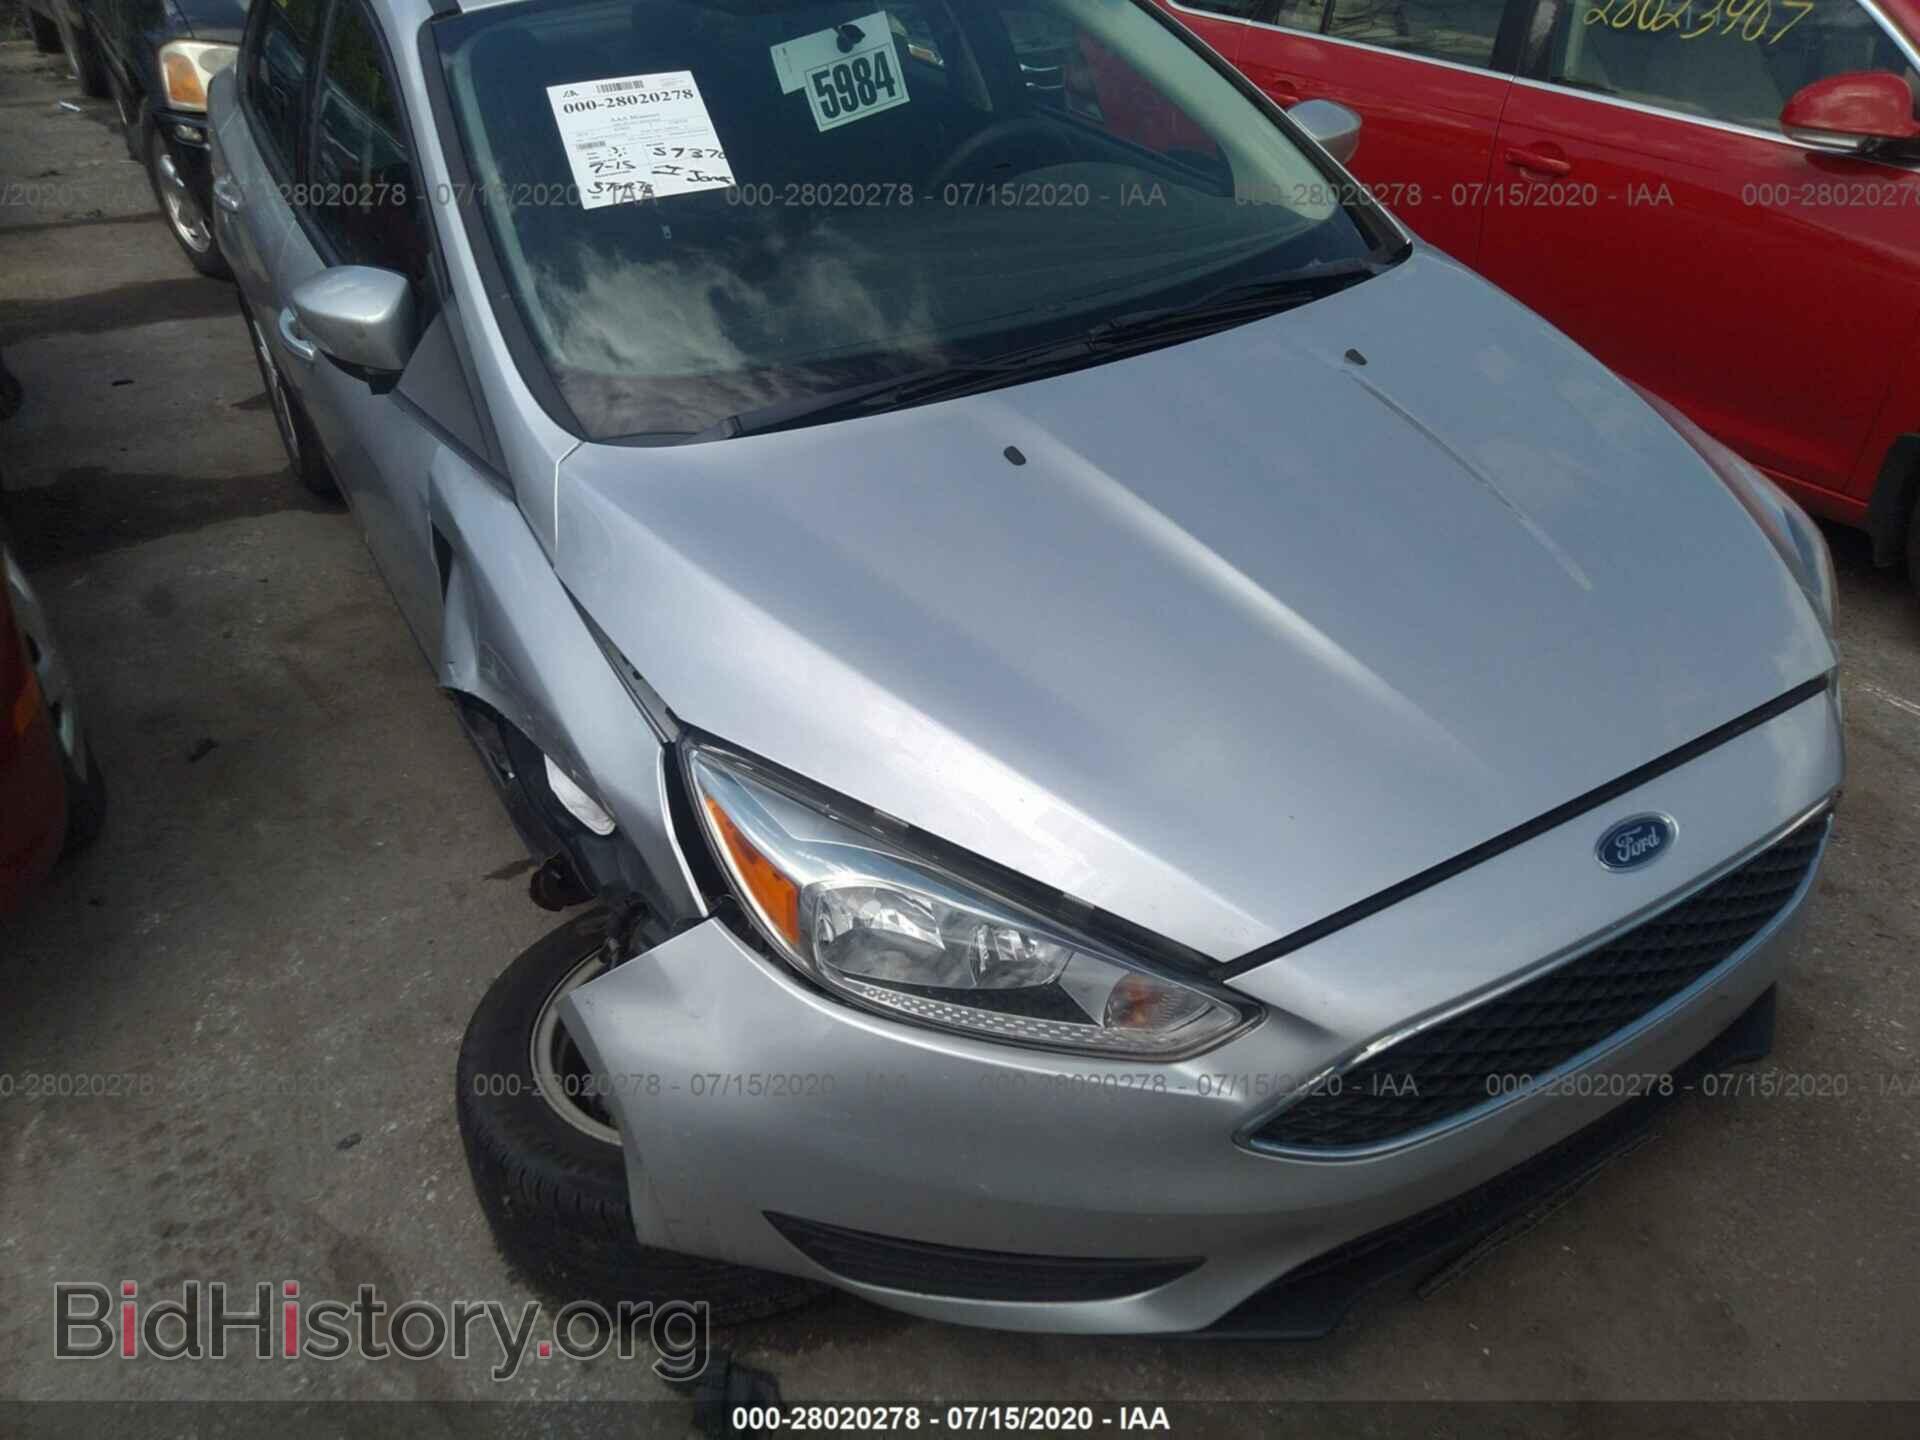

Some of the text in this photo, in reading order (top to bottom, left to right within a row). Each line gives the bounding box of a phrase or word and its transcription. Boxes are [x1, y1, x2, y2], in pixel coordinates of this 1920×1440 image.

[563, 88, 694, 114] 000-28020278
[812, 51, 896, 119] 5984
[1616, 826, 1660, 862] Ford
